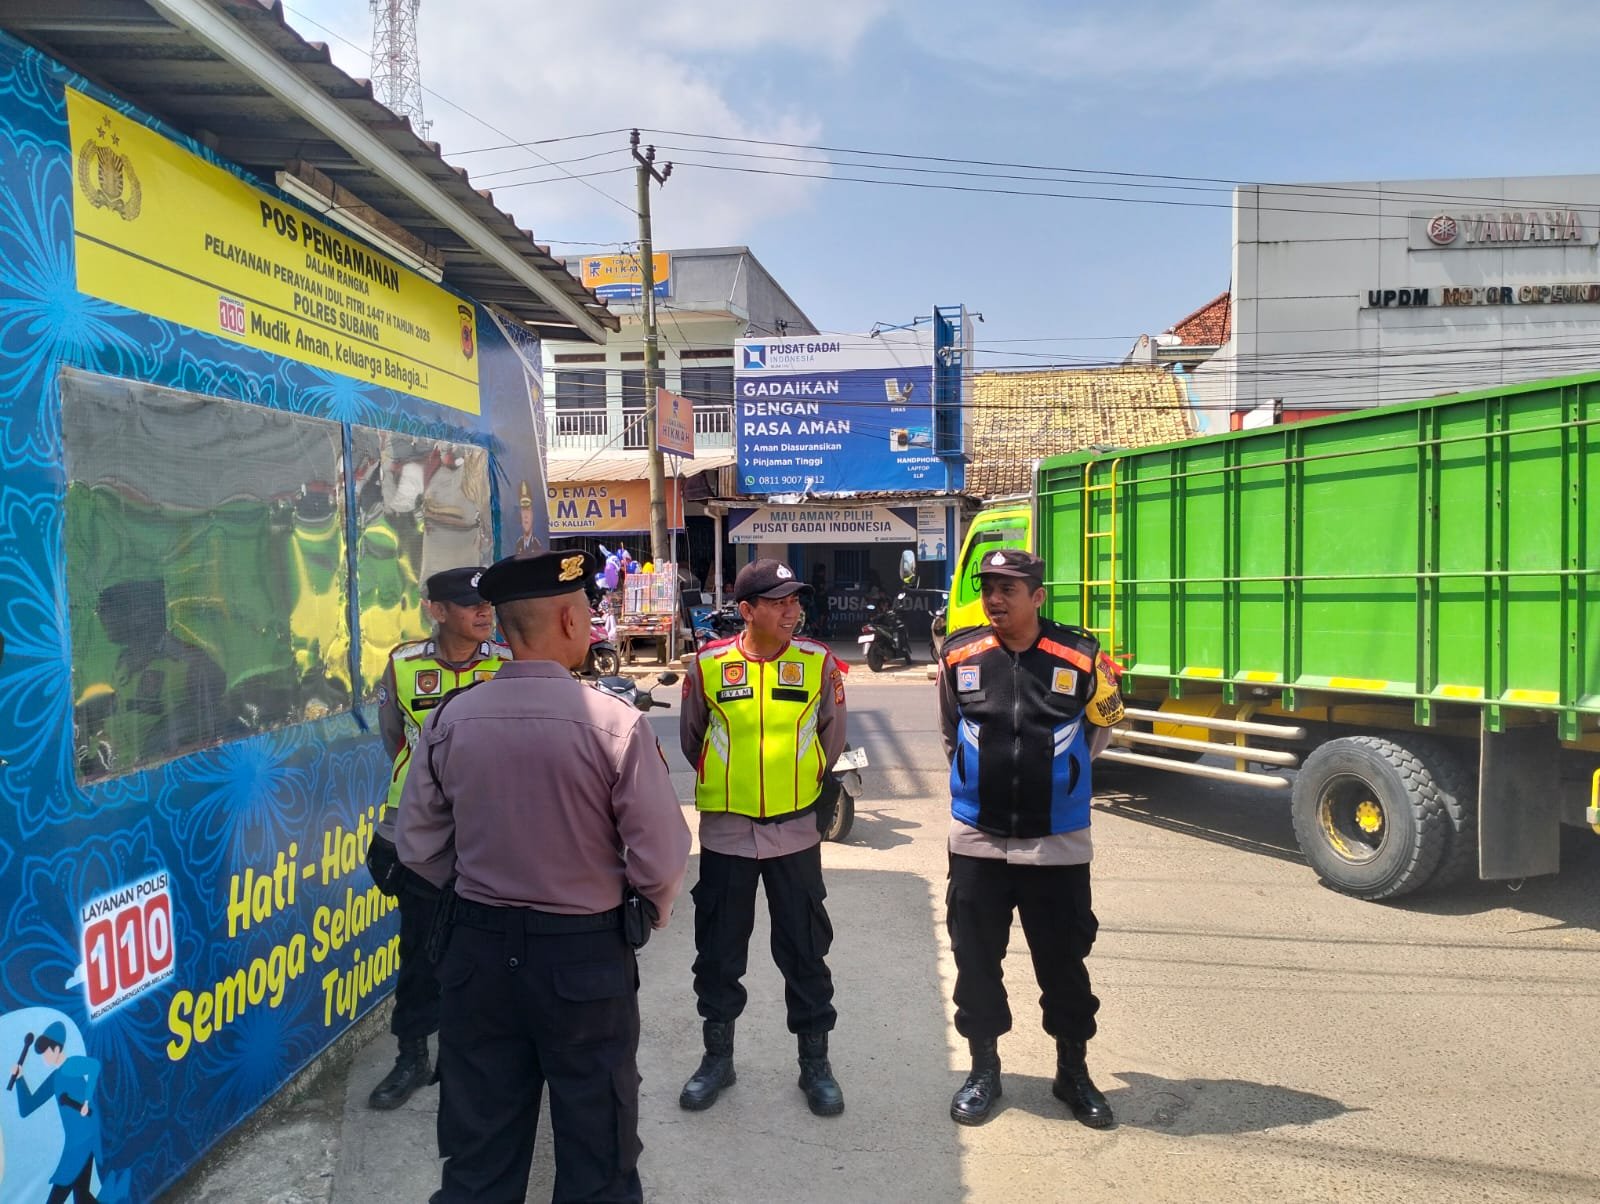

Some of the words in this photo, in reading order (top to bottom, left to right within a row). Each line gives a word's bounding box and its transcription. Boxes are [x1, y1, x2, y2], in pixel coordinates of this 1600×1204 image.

[1463, 211, 1582, 244] YAMAHA
[260, 200, 298, 241] POS
[302, 221, 400, 293] PENGAMANAN
[306, 253, 335, 280] DALAM
[336, 269, 370, 296] RANGKA
[205, 233, 271, 276] PELAYANAN
[274, 264, 323, 298] PERAYAAN
[325, 286, 344, 307] IDUL
[346, 296, 365, 315] FITRI
[366, 304, 385, 324] 1447
[386, 312, 392, 326] H
[392, 315, 414, 336] TAHUN
[1368, 288, 1429, 306] UPDM
[1443, 286, 1513, 306] MOTOR
[294, 292, 337, 325] POLRES
[339, 312, 379, 341] SUBANG
[220, 304, 244, 333] 110
[251, 311, 291, 344] Mudik
[295, 328, 333, 360] Aman,
[335, 341, 382, 379] Keluarga
[770, 344, 805, 354] PUSAT
[807, 342, 840, 352] GADAI
[770, 355, 815, 363] INDONESIA
[743, 379, 839, 396] GADAIKAN
[744, 400, 819, 416] DENGAN
[744, 421, 792, 436] RASA
[797, 420, 850, 435] AMAN
[753, 444, 778, 452] Aman
[781, 442, 842, 451] Diasuransikan
[753, 458, 792, 467] Pinjaman
[795, 457, 823, 466] Tinggi
[759, 476, 779, 485] 0811
[781, 476, 802, 484] 9007
[562, 487, 607, 498] EMAS
[770, 511, 796, 522] MAU
[800, 510, 840, 521] AMAN?
[843, 510, 873, 520] PILIH
[752, 522, 788, 533] PUSAT
[791, 522, 825, 532] GADAI
[829, 521, 892, 532] INDONESIA
[227, 842, 298, 938] Hati
[321, 806, 374, 885] Hati
[82, 888, 134, 922] LAYANAN
[137, 873, 168, 899] POLISI
[87, 902, 171, 995] 110
[166, 933, 306, 1061] Semoga
